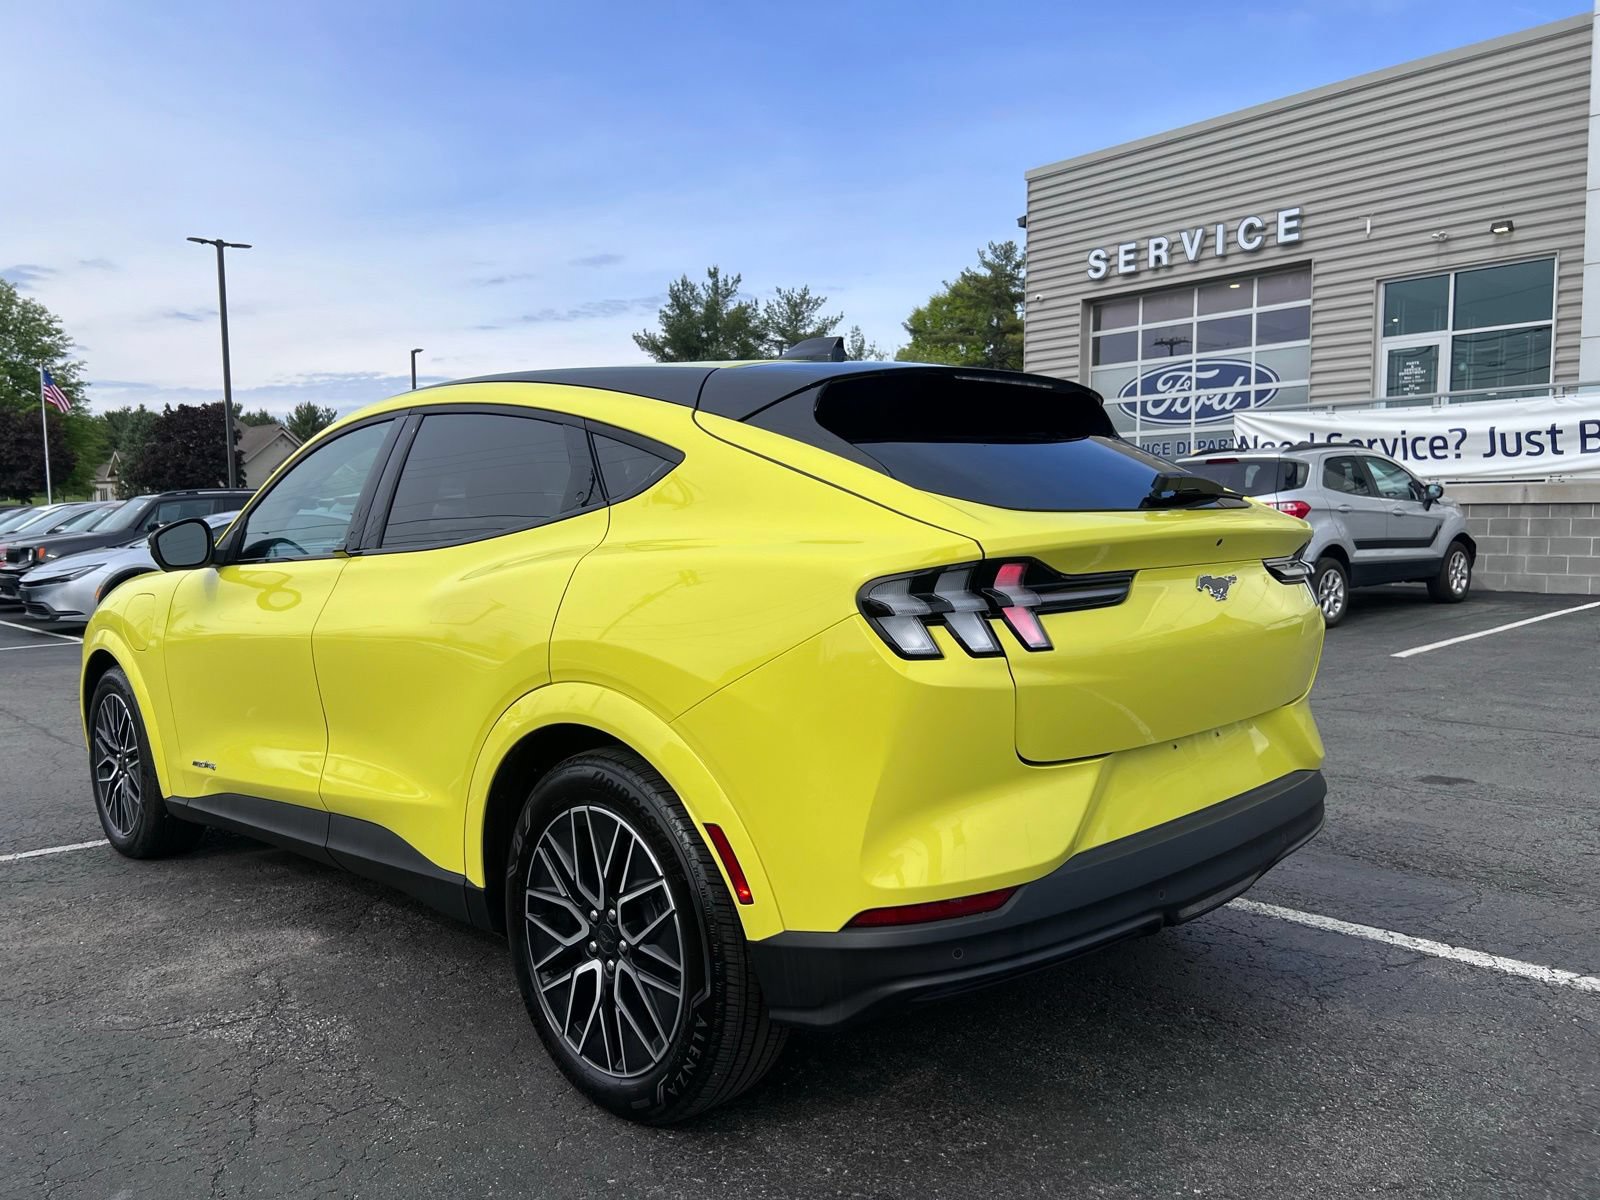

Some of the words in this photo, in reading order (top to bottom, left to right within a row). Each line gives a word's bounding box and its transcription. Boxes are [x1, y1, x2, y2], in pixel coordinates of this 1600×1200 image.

[1087, 207, 1303, 281] SERVICE
[1147, 369, 1245, 416] Ford
[1483, 424, 1565, 458] Just
[666, 1012, 709, 1097] ALENZA
